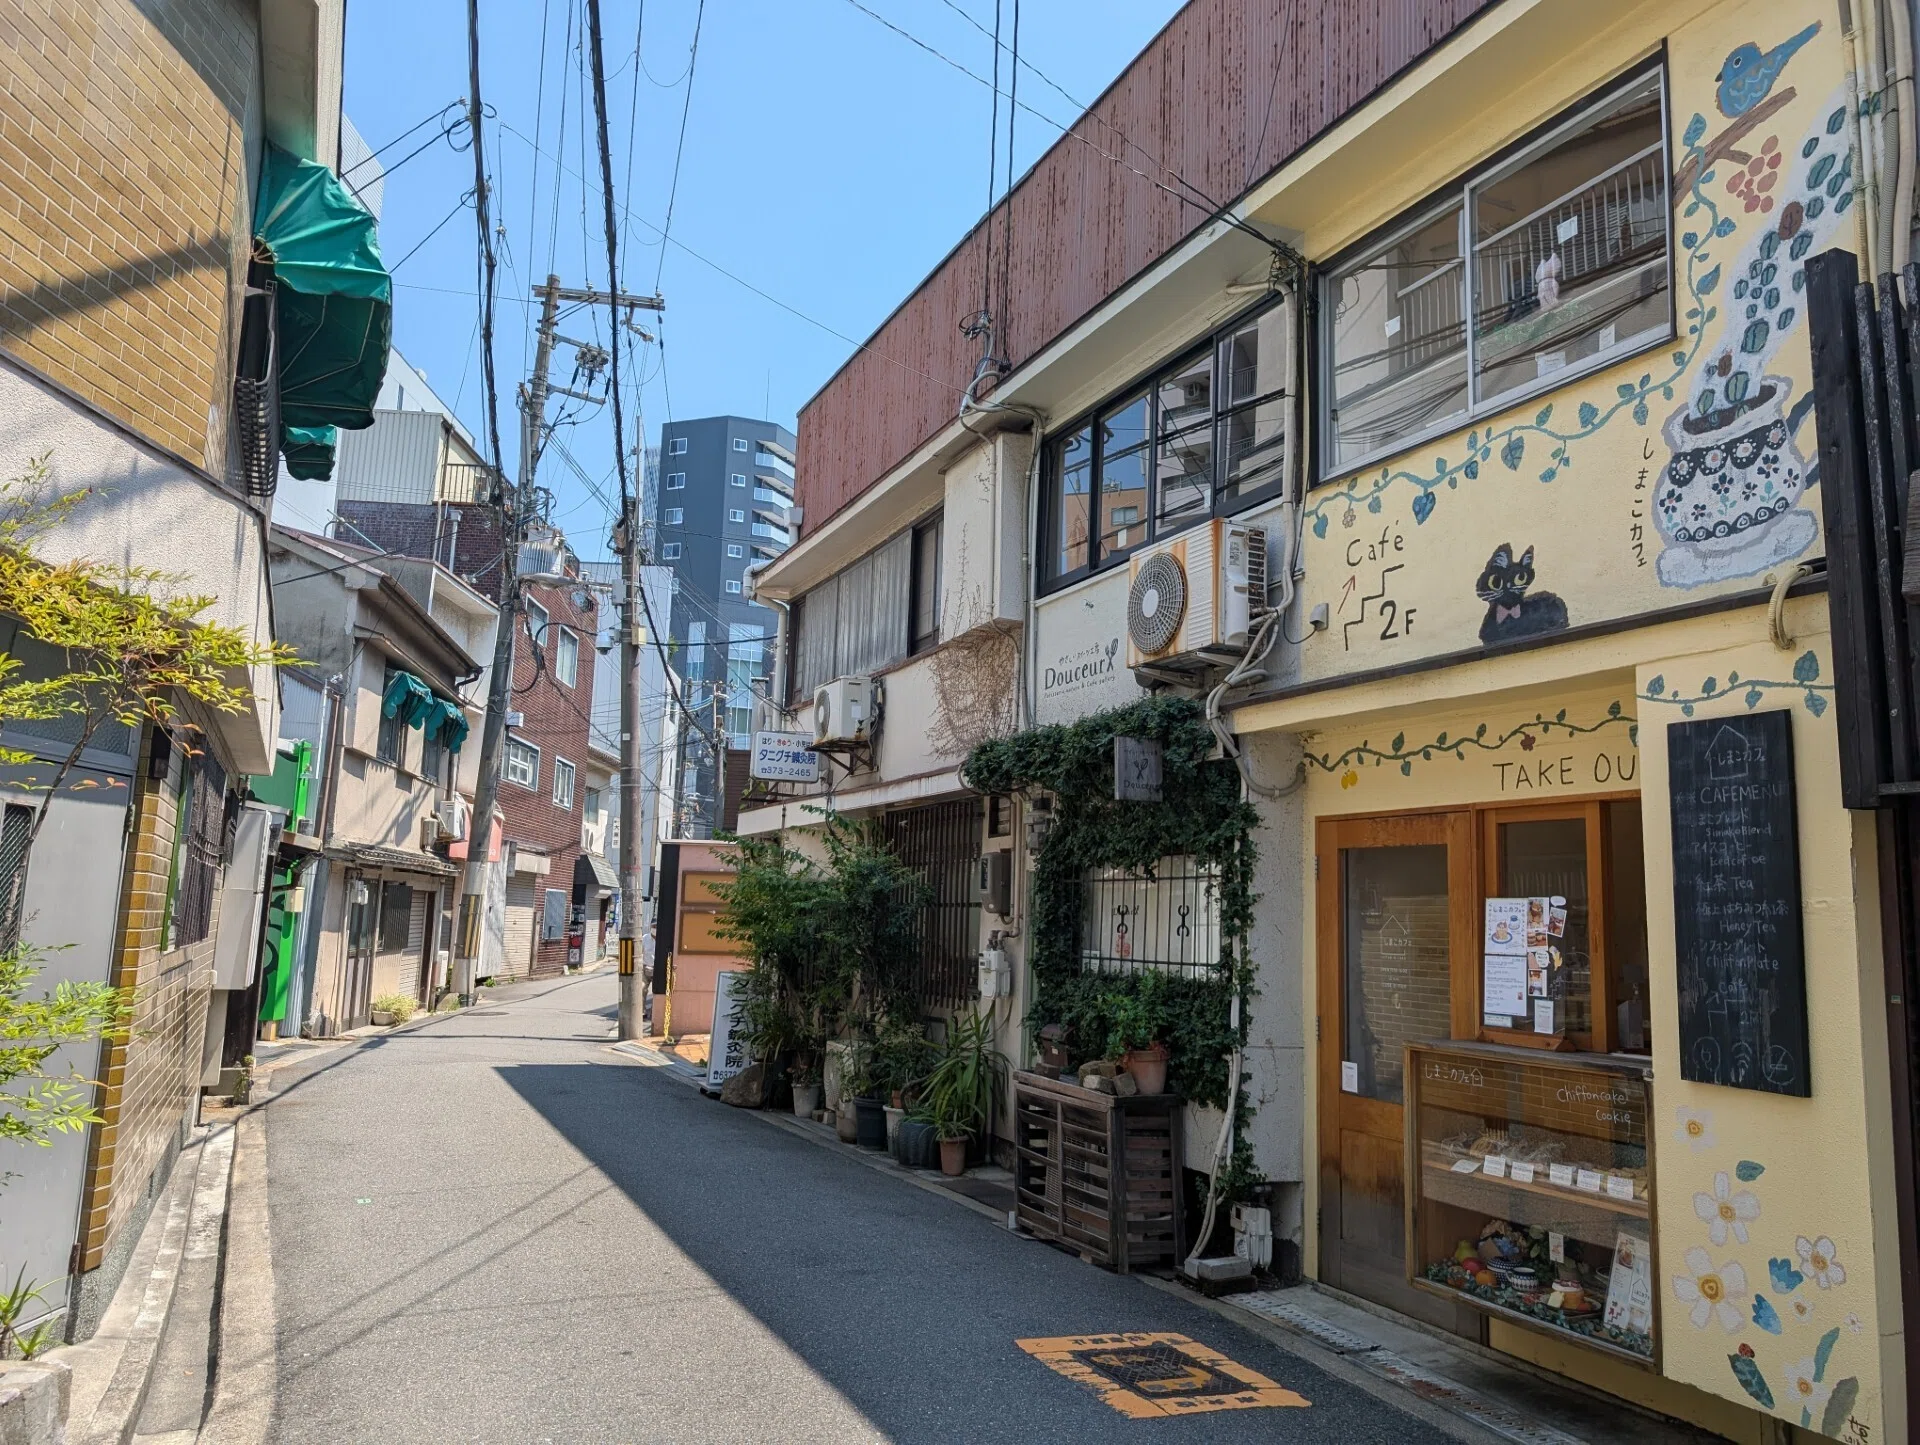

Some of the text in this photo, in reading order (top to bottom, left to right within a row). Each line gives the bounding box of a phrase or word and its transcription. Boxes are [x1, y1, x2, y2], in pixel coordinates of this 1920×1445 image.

[1629, 438, 1655, 568] しまこカフェ
[1346, 519, 1404, 567] Café
[1379, 599, 1417, 641] 2F
[1044, 658, 1106, 691] Douceur
[759, 749, 817, 765] タニグチ鍼灸院
[1718, 747, 1766, 766] しまこカフェ
[767, 766, 811, 777] 373-2465
[1493, 753, 1636, 791] TAKE OU
[1695, 873, 1754, 894] 紅茶 Tea
[1424, 1063, 1470, 1083] しまこカフェ
